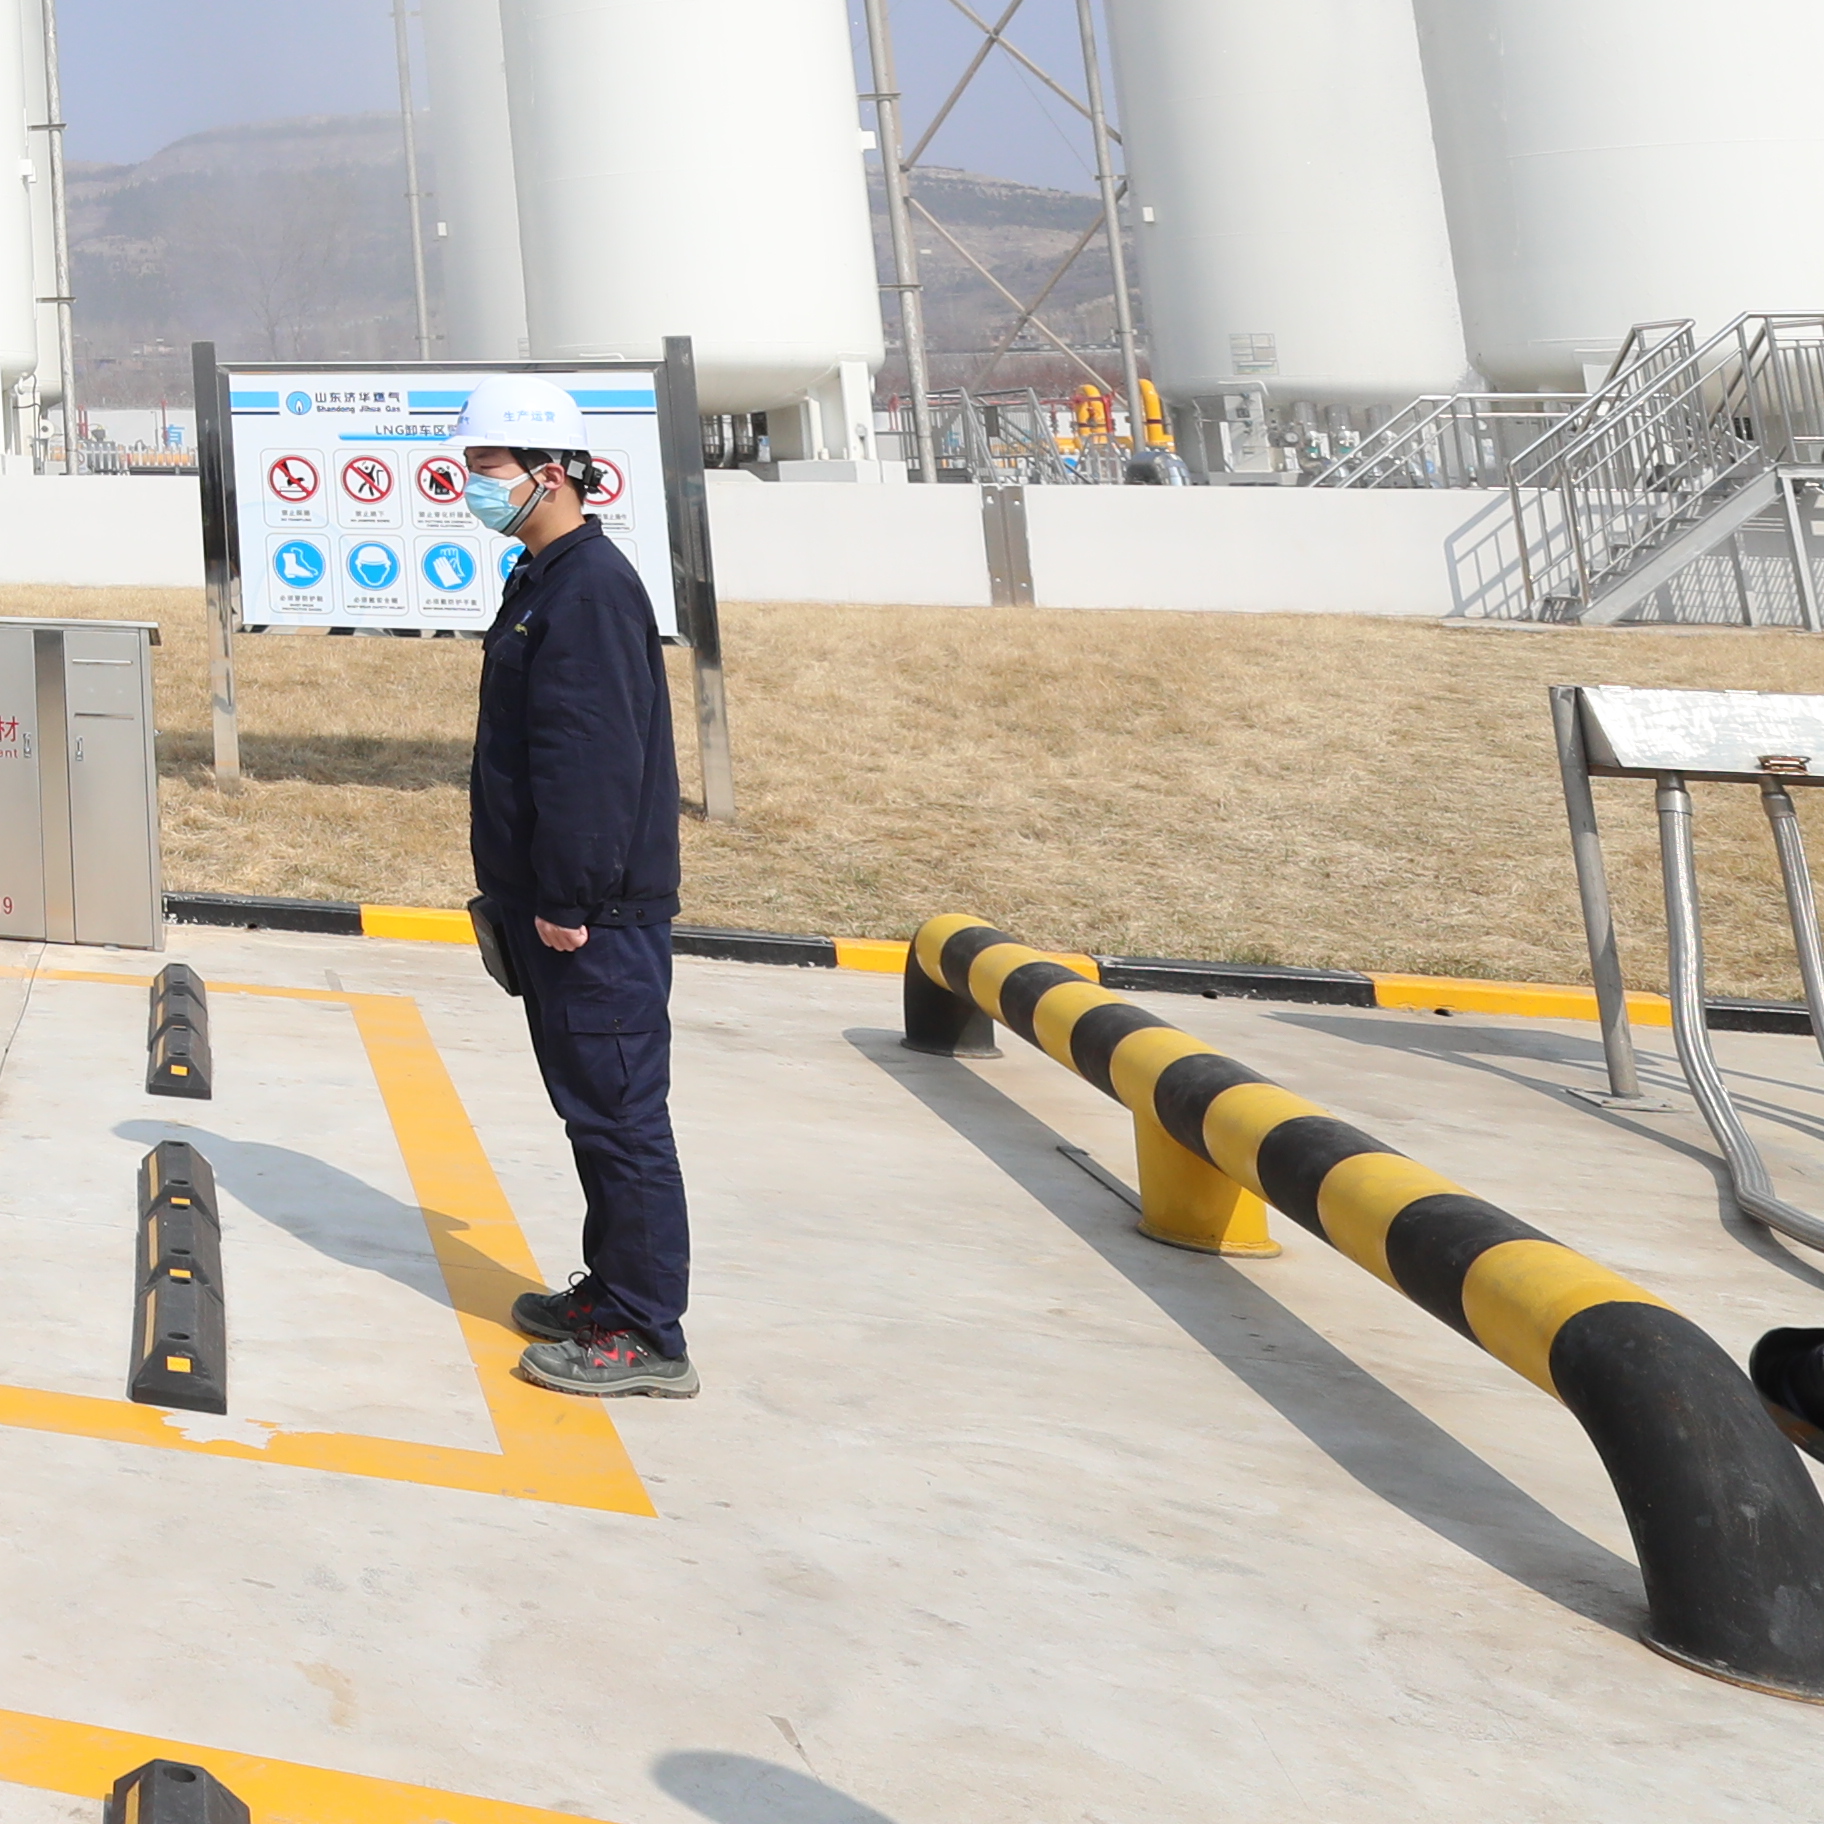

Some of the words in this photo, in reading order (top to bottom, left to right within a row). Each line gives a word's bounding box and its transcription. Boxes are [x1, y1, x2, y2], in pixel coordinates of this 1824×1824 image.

[315, 391, 401, 403] 山东济华燃气
[316, 405, 355, 414] Shandong
[503, 410, 556, 423] 生产运营
